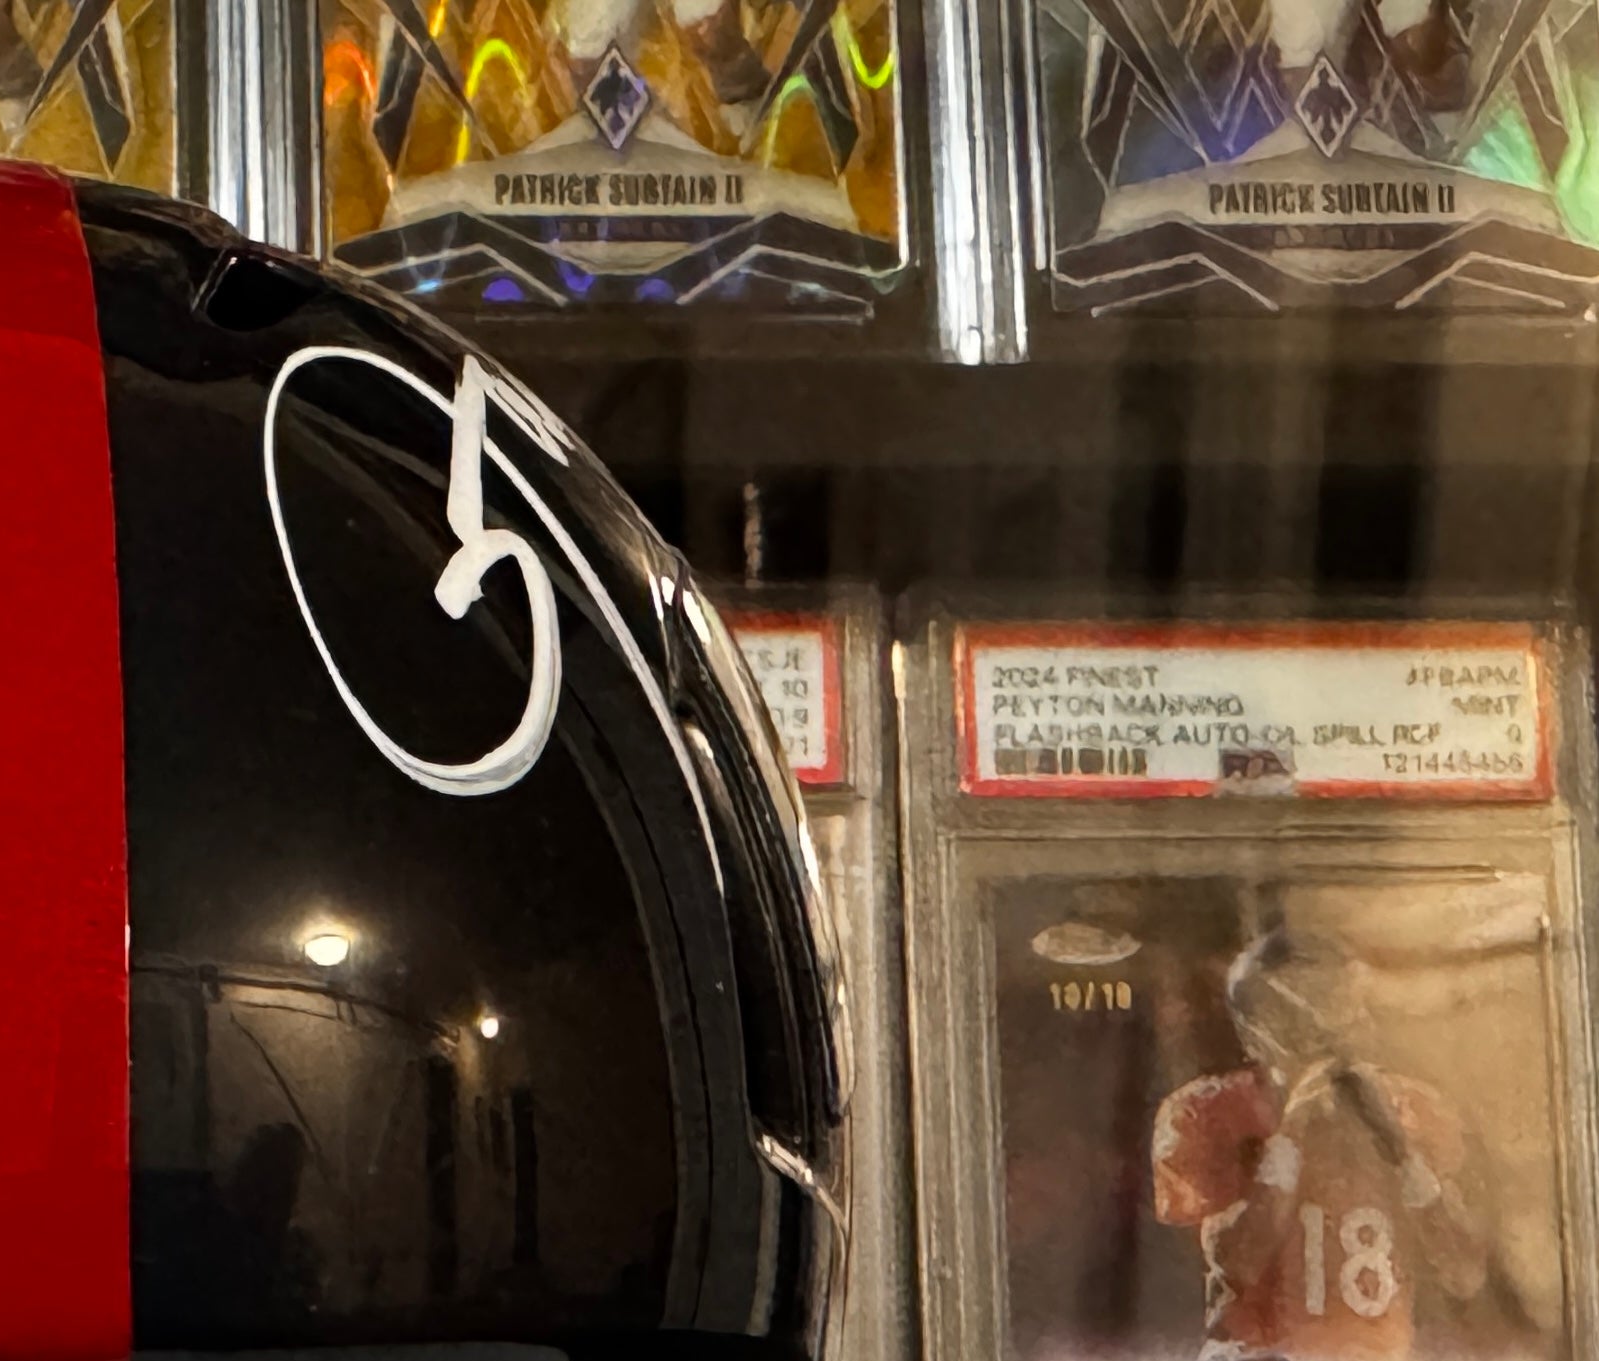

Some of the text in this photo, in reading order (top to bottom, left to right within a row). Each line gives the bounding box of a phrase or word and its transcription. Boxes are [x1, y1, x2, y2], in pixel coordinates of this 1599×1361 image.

[494, 173, 601, 205] PATRICK
[608, 173, 717, 206] SURTAIN
[1208, 181, 1315, 214] PATRICK
[1321, 182, 1430, 214] SURTAIN
[992, 693, 1245, 717] PEYTON MANNING
[1300, 1205, 1399, 1318] 18
